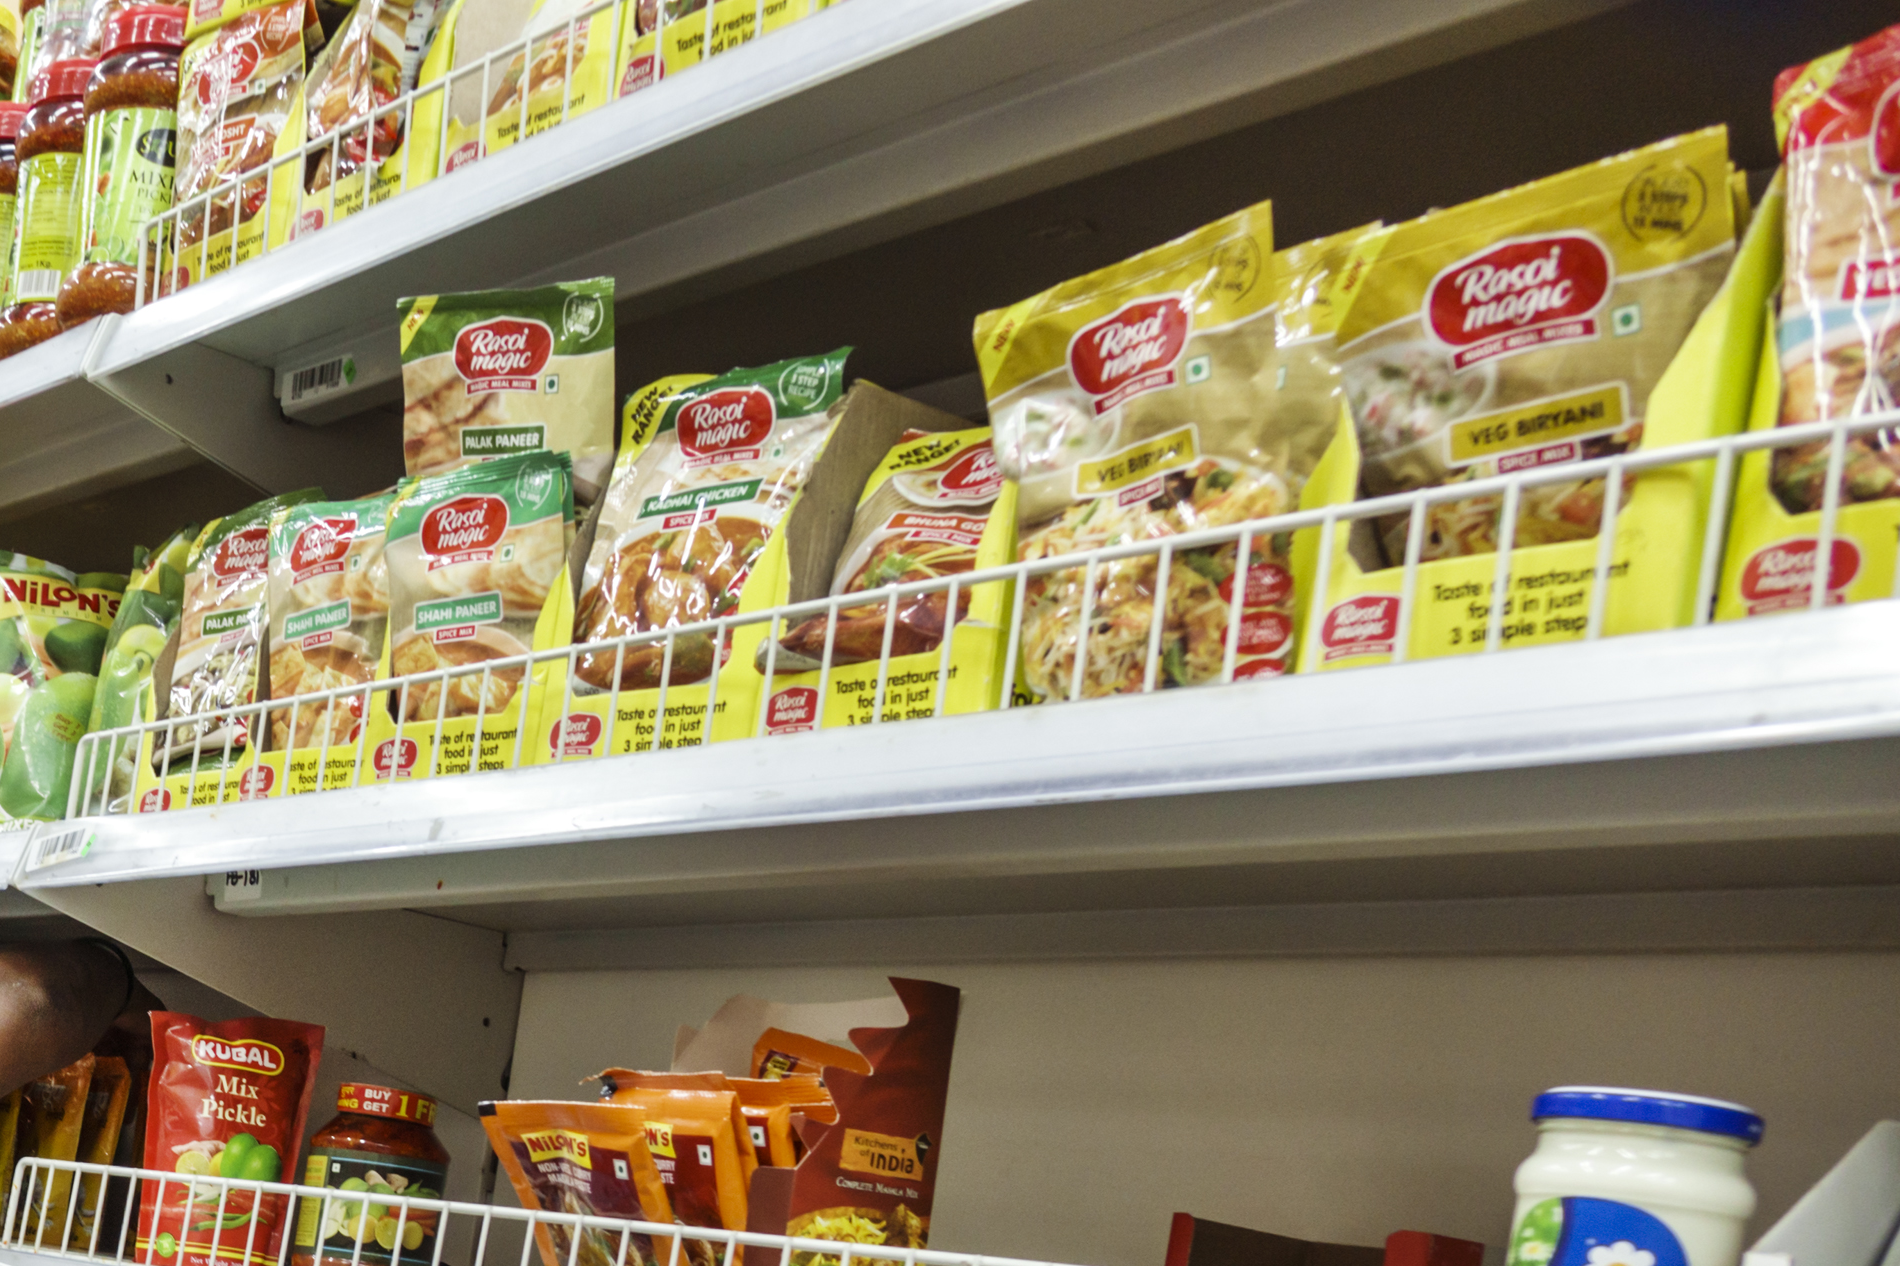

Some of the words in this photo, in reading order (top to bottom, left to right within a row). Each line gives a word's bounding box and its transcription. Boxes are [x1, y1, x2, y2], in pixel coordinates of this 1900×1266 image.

[1461, 248, 1560, 303] Rasoi
[1464, 275, 1573, 325] magic
[470, 328, 529, 354] Rasoi
[1097, 306, 1170, 356] Rasoi
[470, 351, 531, 375] magic
[1102, 336, 1176, 383] magic
[692, 395, 745, 430] Rasoi
[1466, 422, 1505, 447] VEG
[1509, 402, 1606, 438] BIRYANI
[465, 435, 493, 449] PALAK
[496, 433, 540, 447] PANEER
[692, 415, 752, 449] magic
[889, 439, 961, 470] RANGE!
[898, 440, 942, 464] NEW
[647, 495, 694, 515] KADHAI
[697, 486, 748, 506] CHICKEN
[438, 503, 486, 531] Rasoi
[665, 517, 690, 529] SPICE
[904, 515, 956, 529] BHUNA
[438, 522, 490, 550] magic
[1431, 582, 1485, 606] Taste
[1536, 590, 1586, 618] just
[317, 608, 349, 627] PANEER
[418, 604, 452, 621] SHAHI
[456, 600, 497, 618] PANEER
[206, 616, 234, 631] PALAK
[436, 629, 455, 641] SPICE
[457, 627, 474, 638] MIX
[304, 635, 320, 646] SPICE
[321, 632, 332, 643] MIX
[836, 680, 867, 696] Taste
[616, 706, 647, 722] Taste
[444, 745, 465, 759] food
[479, 744, 498, 759] just
[478, 759, 505, 774] steps
[199, 1040, 277, 1069] KUBAL
[215, 1074, 260, 1100] Mix
[200, 1099, 267, 1128] Pickle
[363, 1100, 390, 1114] GET
[364, 1088, 391, 1102] BUY
[396, 1095, 409, 1117] 1
[526, 1134, 587, 1158] NiLON'S
[854, 1135, 898, 1153] Kitchens
[836, 1177, 872, 1193] COMPLETE
